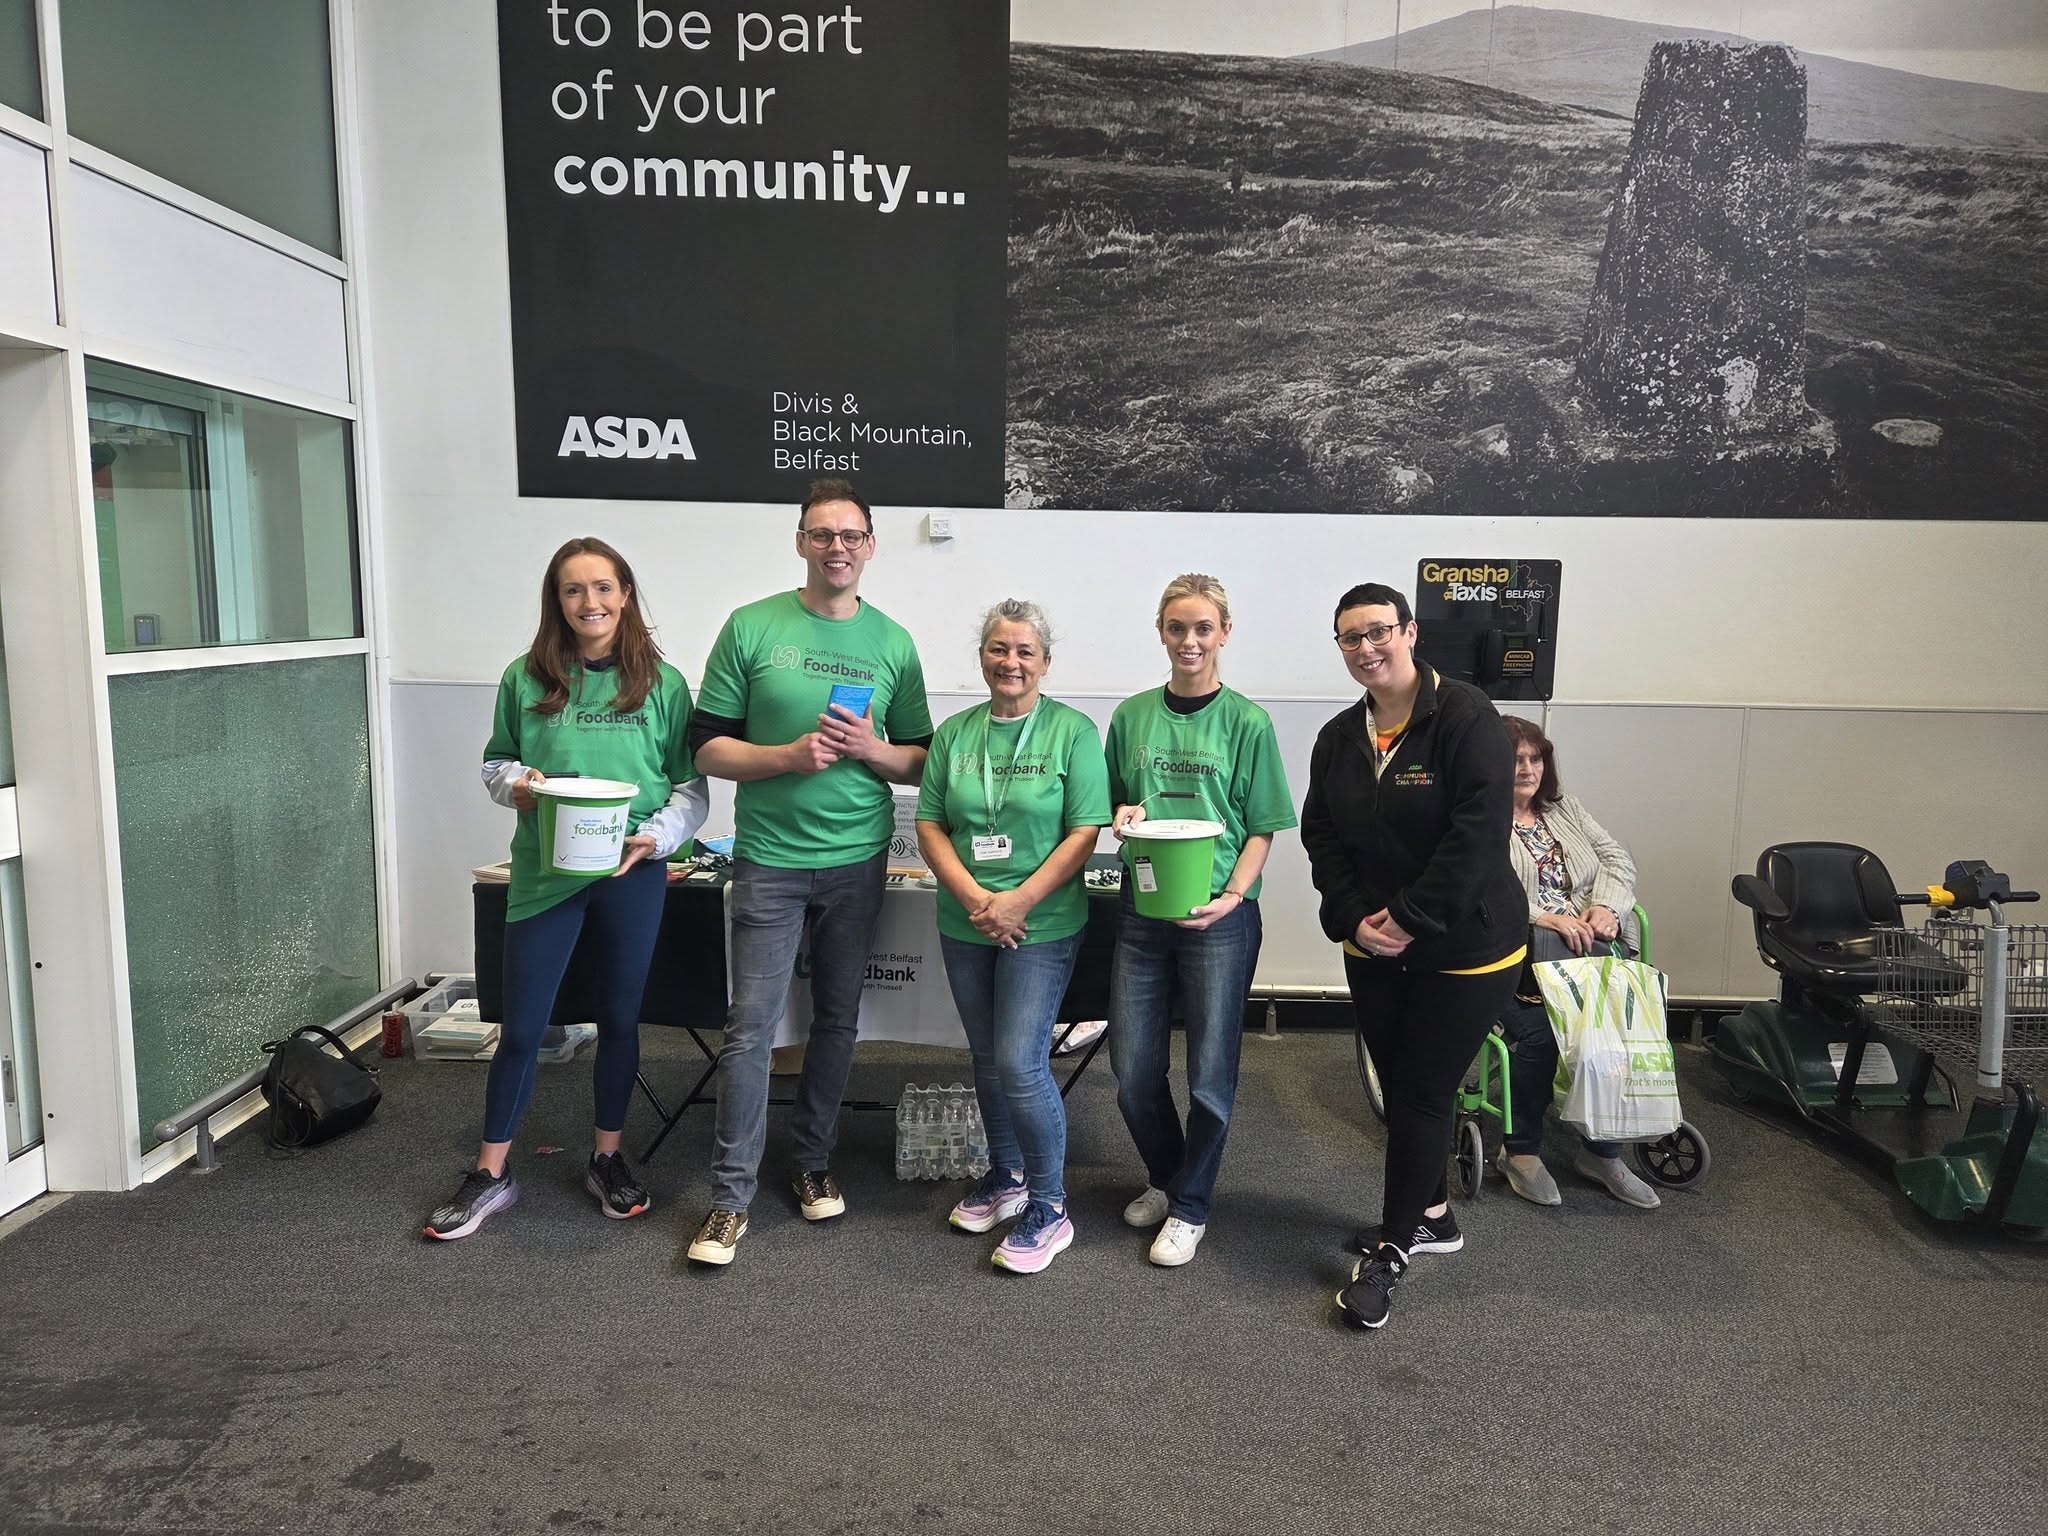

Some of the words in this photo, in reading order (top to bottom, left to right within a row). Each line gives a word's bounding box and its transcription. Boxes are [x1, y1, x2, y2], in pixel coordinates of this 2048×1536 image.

[547, 0, 611, 47] to
[637, 0, 711, 50] be
[737, 4, 863, 61] part
[551, 69, 613, 120] of
[635, 85, 776, 132] your
[553, 150, 966, 213] community...
[773, 391, 832, 414] Divis
[841, 393, 859, 414] &
[557, 416, 697, 460] ASDA
[773, 420, 841, 443] Black
[851, 422, 973, 448] Mountain,
[774, 448, 860, 471] Belfast
[1423, 563, 1509, 582] Gransha
[1448, 583, 1497, 601] Taxis
[1506, 590, 1545, 599] BELFAST
[804, 647, 854, 662] South-West
[855, 657, 879, 670] Belfast
[803, 658, 874, 682] Foodbank
[576, 710, 649, 727] Foodbank
[1154, 746, 1198, 758] South-West
[1199, 750, 1225, 763] Belfast
[1153, 757, 1217, 777] Foodbank
[574, 822, 623, 836] foodbank
[890, 953, 923, 964] Belfast
[864, 963, 916, 982] dbank
[1632, 1052, 1674, 1072] ASD
[1624, 1077, 1651, 1087] That's
[1653, 1078, 1676, 1087] more
